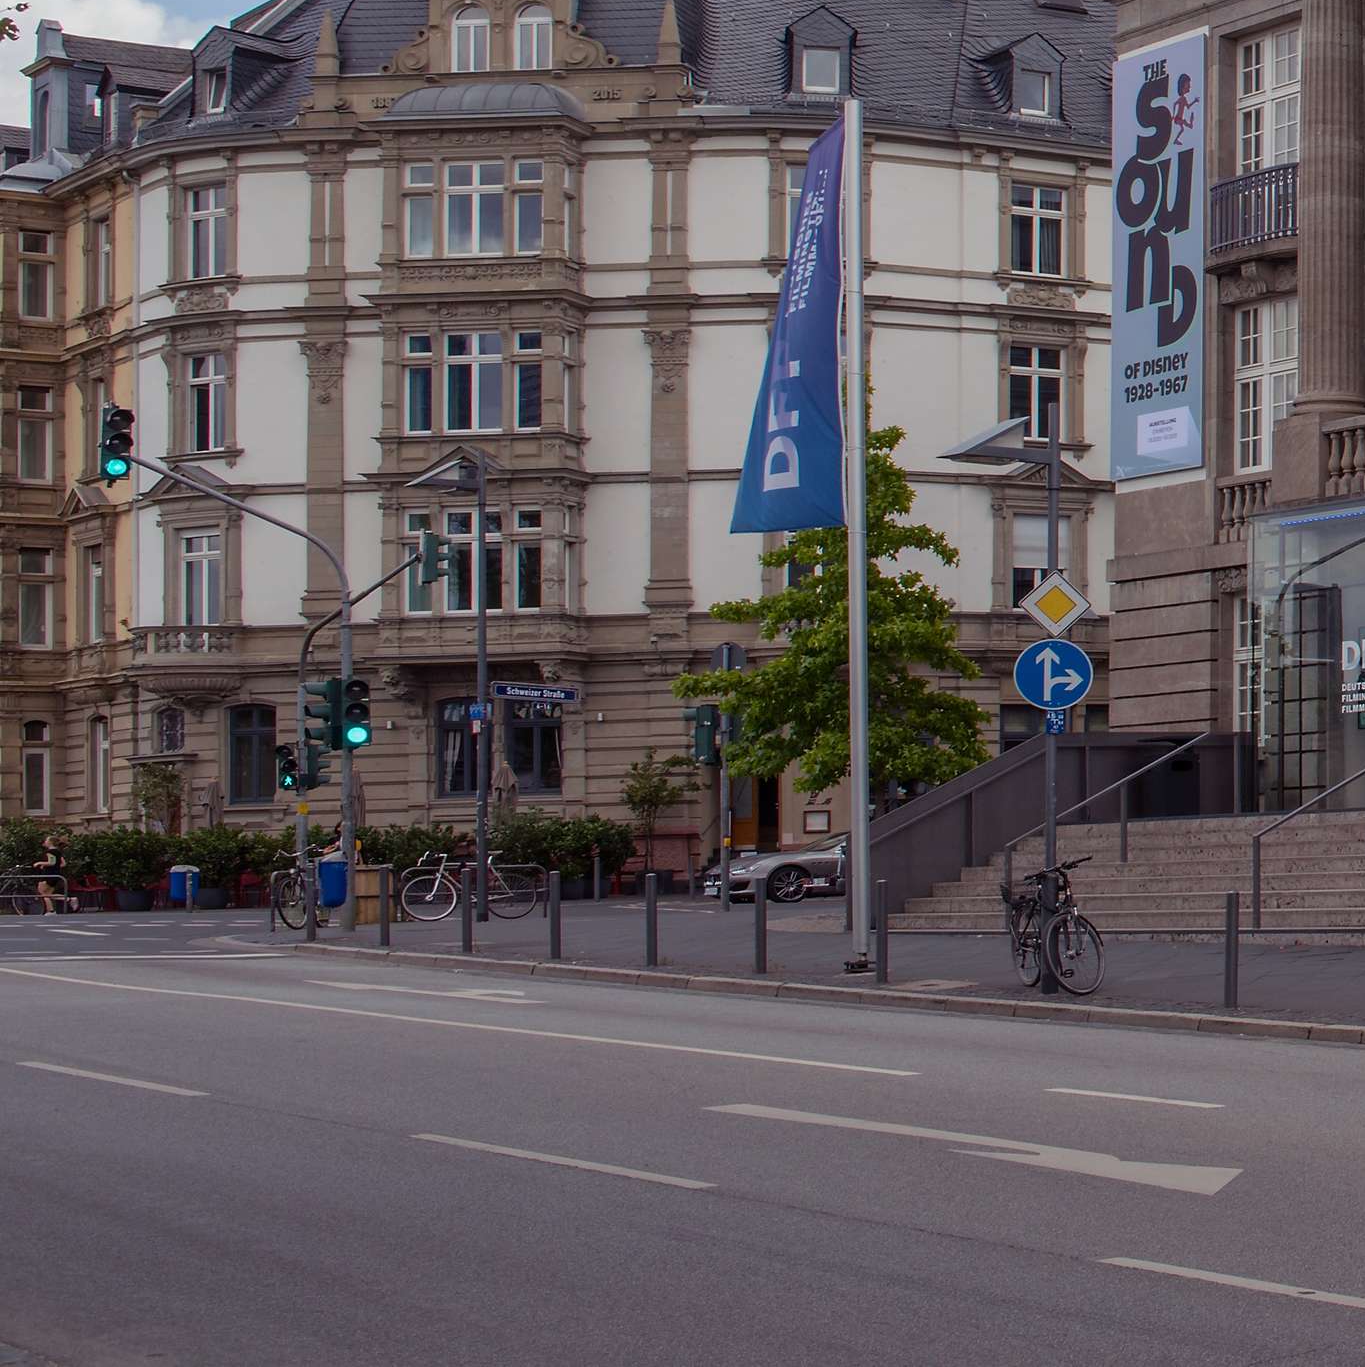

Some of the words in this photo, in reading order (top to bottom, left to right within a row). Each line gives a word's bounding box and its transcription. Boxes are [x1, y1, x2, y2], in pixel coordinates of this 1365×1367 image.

[1143, 59, 1168, 82] THE
[592, 89, 622, 101] 2015
[1124, 362, 1140, 380] OF
[1124, 374, 1188, 403] 1928-1967
[506, 686, 542, 697] Schweizer
[543, 689, 565, 699] Straße
